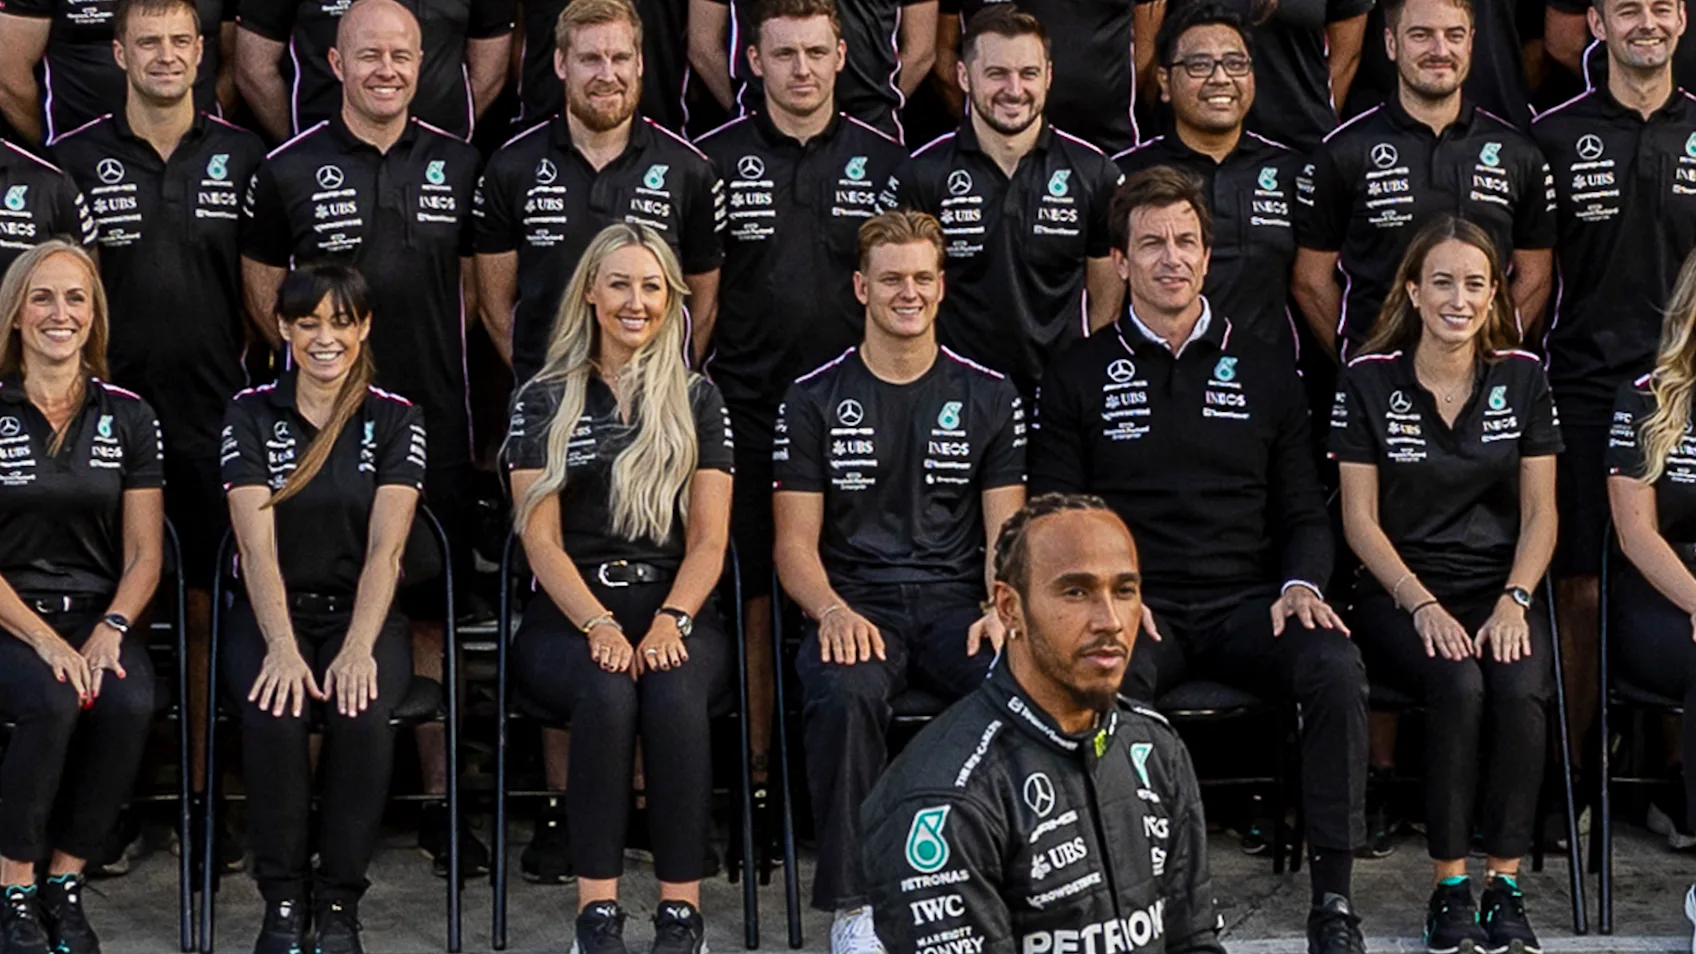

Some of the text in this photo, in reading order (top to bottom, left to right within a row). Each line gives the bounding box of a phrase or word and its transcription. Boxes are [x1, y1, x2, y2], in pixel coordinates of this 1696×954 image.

[1381, 179, 1409, 193] UBS
[1473, 174, 1510, 193] INEOS
[1587, 172, 1615, 187] UBS
[107, 197, 137, 211] UBS
[419, 195, 456, 210] INEOS
[536, 198, 564, 212] UBS
[746, 192, 772, 206] UBS
[836, 191, 875, 205] INEOS
[329, 201, 357, 215] UBS
[630, 198, 670, 216] INEOS
[1038, 207, 1078, 222] INEOS
[954, 208, 981, 222] UBS
[1120, 391, 1147, 406] UBS
[1205, 391, 1246, 407] INEOS
[847, 440, 874, 454] UBS
[928, 441, 970, 456] INEOS
[1047, 836, 1088, 871] UBS
[901, 869, 970, 892] PETRONAS
[909, 895, 965, 925] IWC
[916, 926, 972, 947] MARRIOTT
